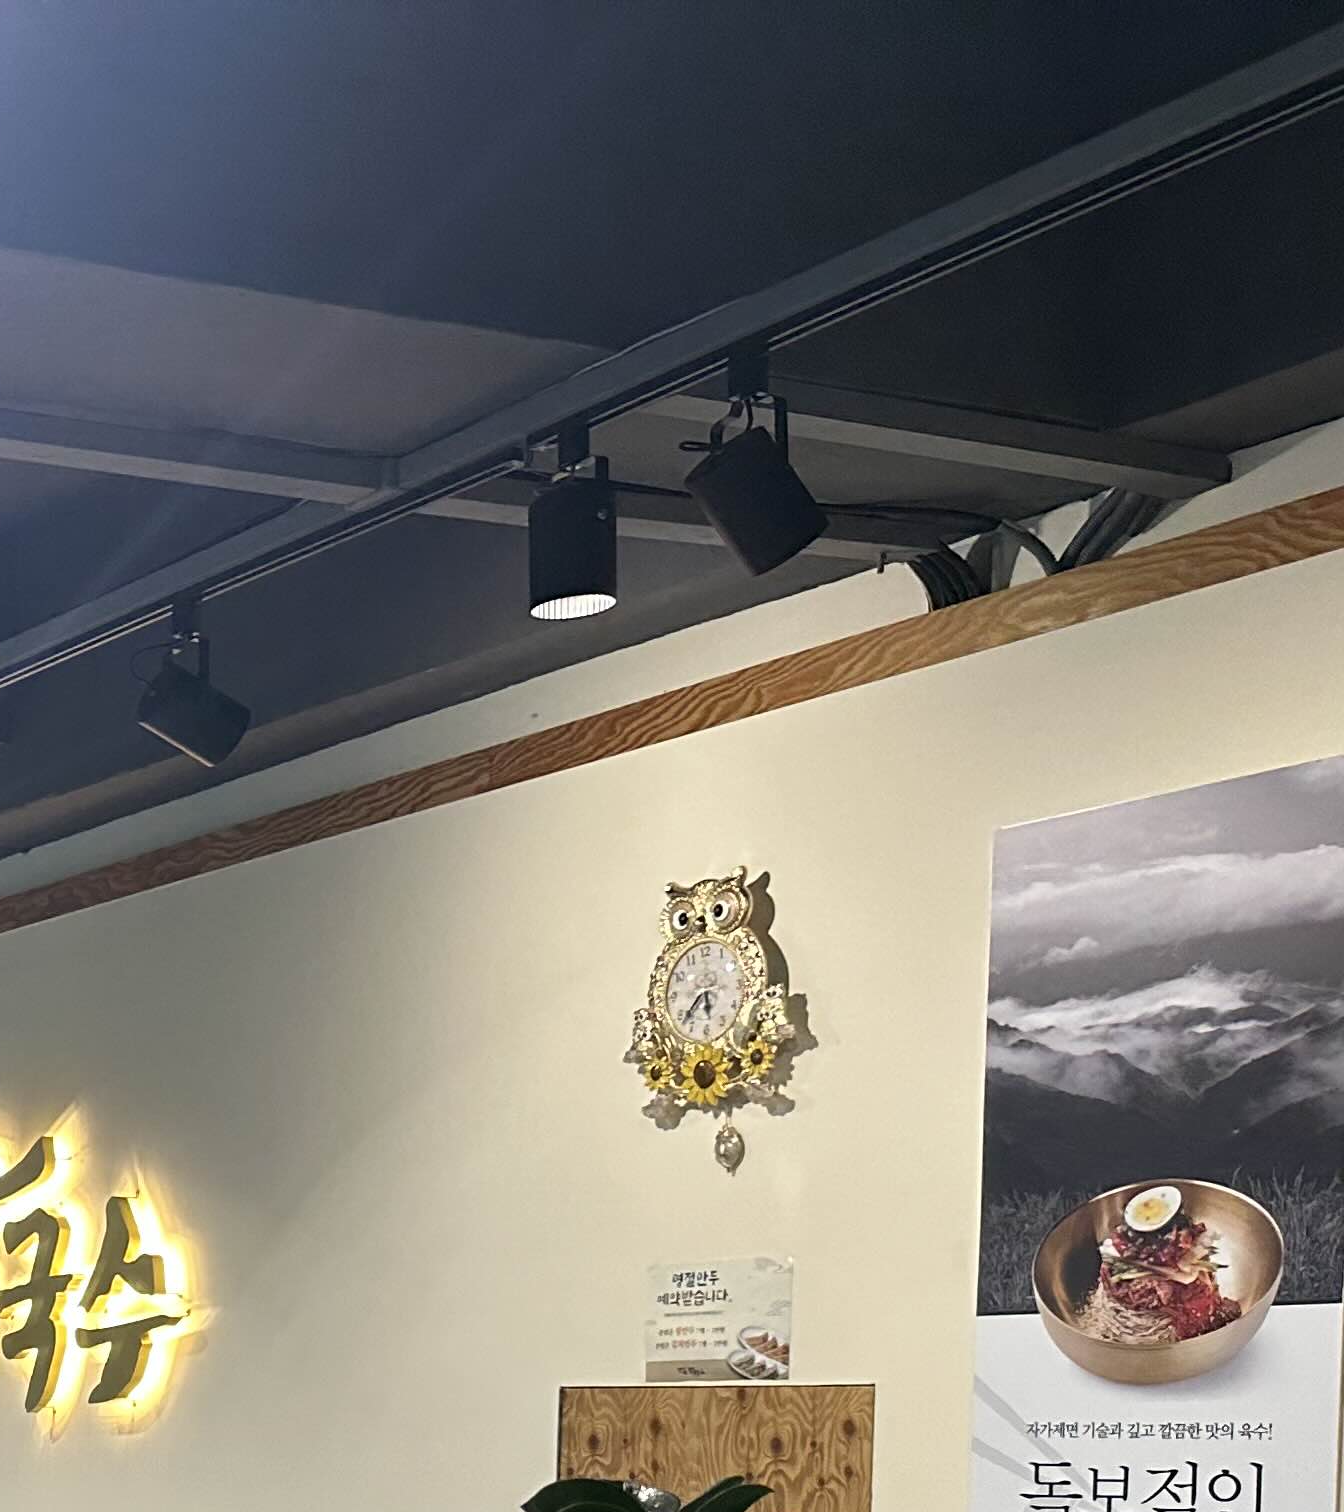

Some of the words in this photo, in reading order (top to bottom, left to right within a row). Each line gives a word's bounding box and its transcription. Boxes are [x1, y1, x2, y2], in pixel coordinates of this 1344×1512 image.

[1025, 1421, 1080, 1440] 자가제면
[1082, 1421, 1125, 1440] 기술과
[1127, 1421, 1157, 1440] 깊고
[1159, 1422, 1203, 1441] 깔끔한
[1206, 1422, 1235, 1441] 맛의
